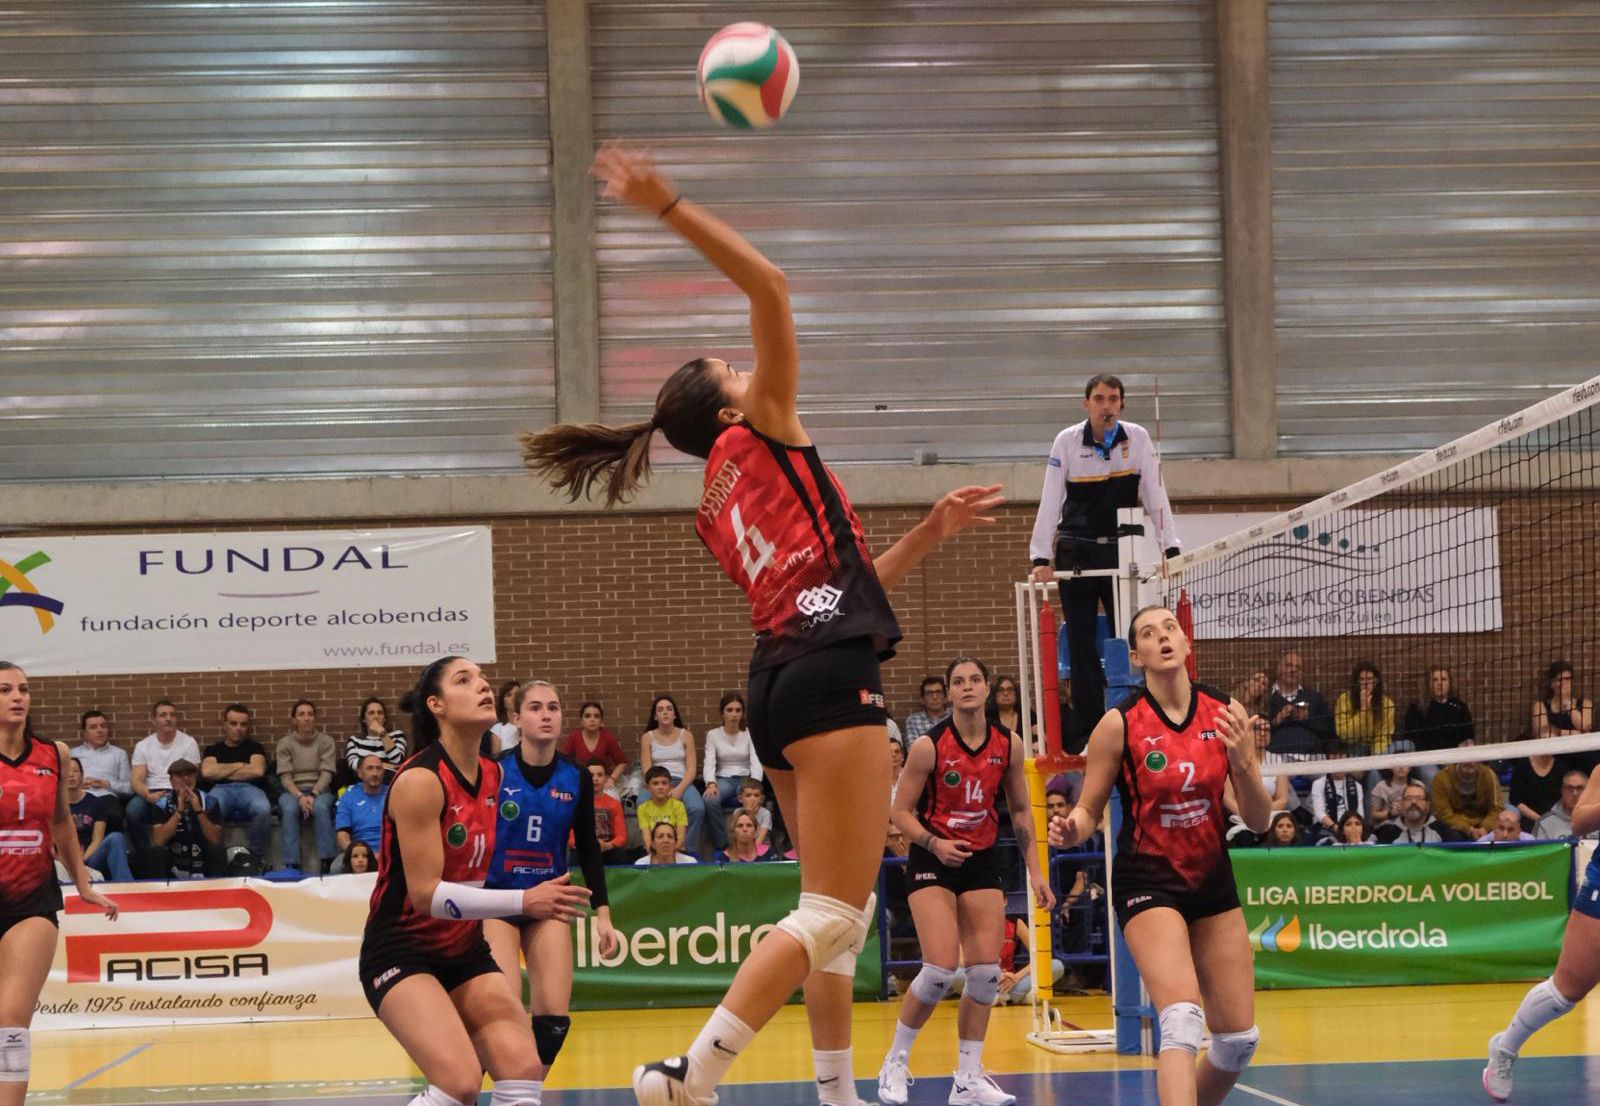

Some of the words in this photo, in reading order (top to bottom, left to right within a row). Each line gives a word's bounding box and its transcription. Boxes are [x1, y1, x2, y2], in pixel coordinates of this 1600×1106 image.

[730, 502, 776, 585] 4
[138, 544, 409, 576] FUNDAL
[1301, 586, 1434, 607] ALCOBENDAS
[80, 613, 208, 632] fundación
[218, 612, 318, 631] deporte
[327, 607, 469, 626] alcobendas
[323, 641, 470, 657] www.fundal.es
[1179, 762, 1196, 792] 2
[965, 780, 984, 804] 14
[18, 792, 25, 820] 1
[526, 815, 543, 842] 6
[468, 833, 486, 868] 11
[1247, 886, 1299, 906] LIGA
[1305, 884, 1436, 905] IBERDROLA
[1441, 881, 1553, 902] VOLEIBOL
[1309, 921, 1448, 950] Iberdrola
[85, 996, 127, 1013] 1975
[129, 993, 223, 1011] instalando
[229, 991, 317, 1012] confianza
